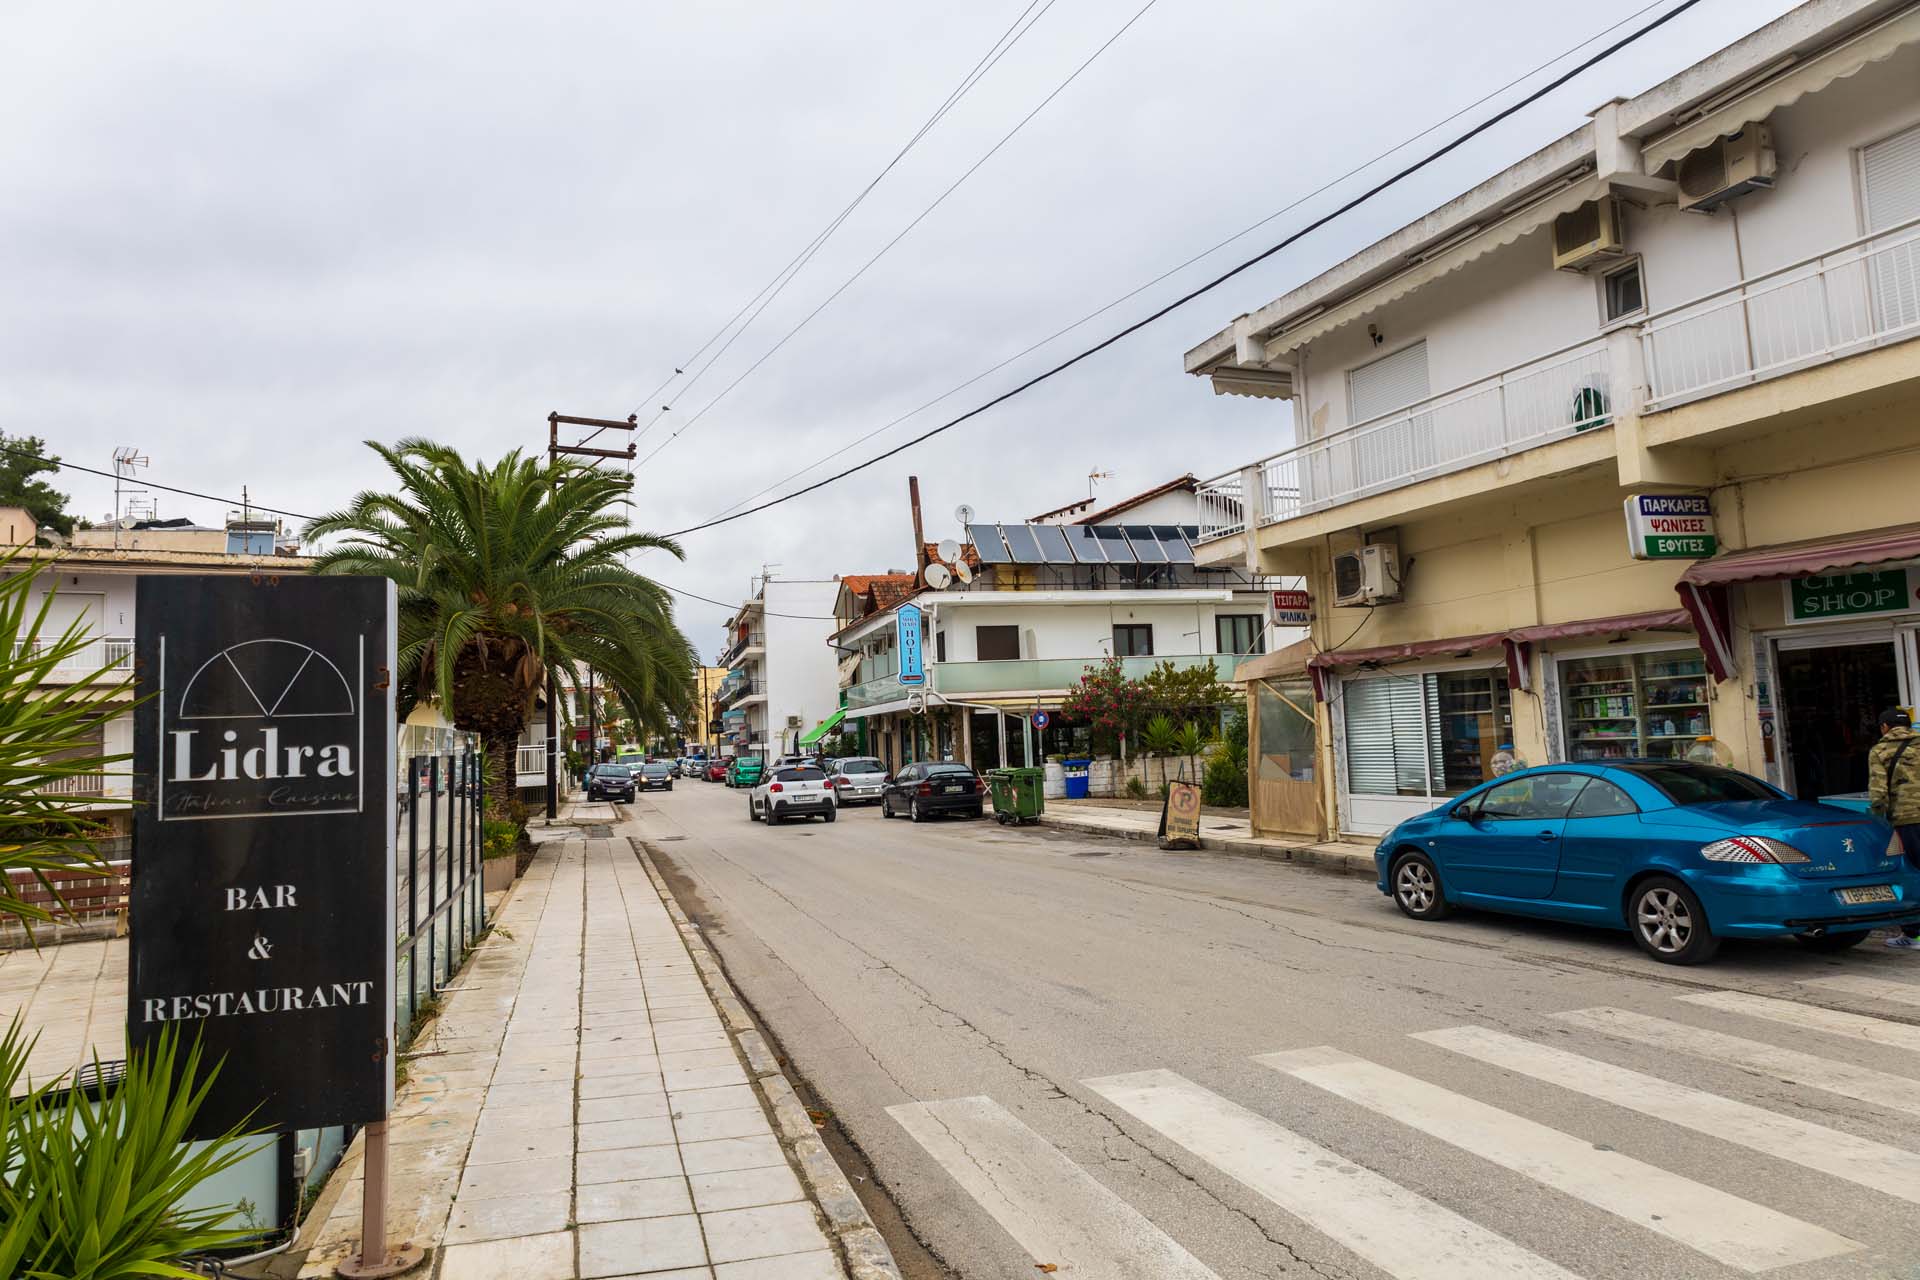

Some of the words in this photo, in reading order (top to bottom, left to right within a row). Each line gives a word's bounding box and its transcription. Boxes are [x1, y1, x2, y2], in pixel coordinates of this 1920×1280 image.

[1642, 498, 1707, 513] ΠΑΡΚΑΡΕΣ
[1650, 518, 1707, 533] ΨΩΝΙΣΕΣ
[1657, 539, 1705, 553] ΕΦΥΓΕΣ
[1275, 594, 1308, 607] ΤΣΙΓΑΡΑ
[1803, 588, 1896, 613] SHOP
[1280, 611, 1308, 622] ΨΙΛΙΚΑ
[905, 630, 916, 673] HOTEL
[168, 727, 355, 782] Lidra
[224, 883, 299, 911] BAR
[247, 935, 275, 960] &
[142, 980, 375, 1023] RESTAURANT
